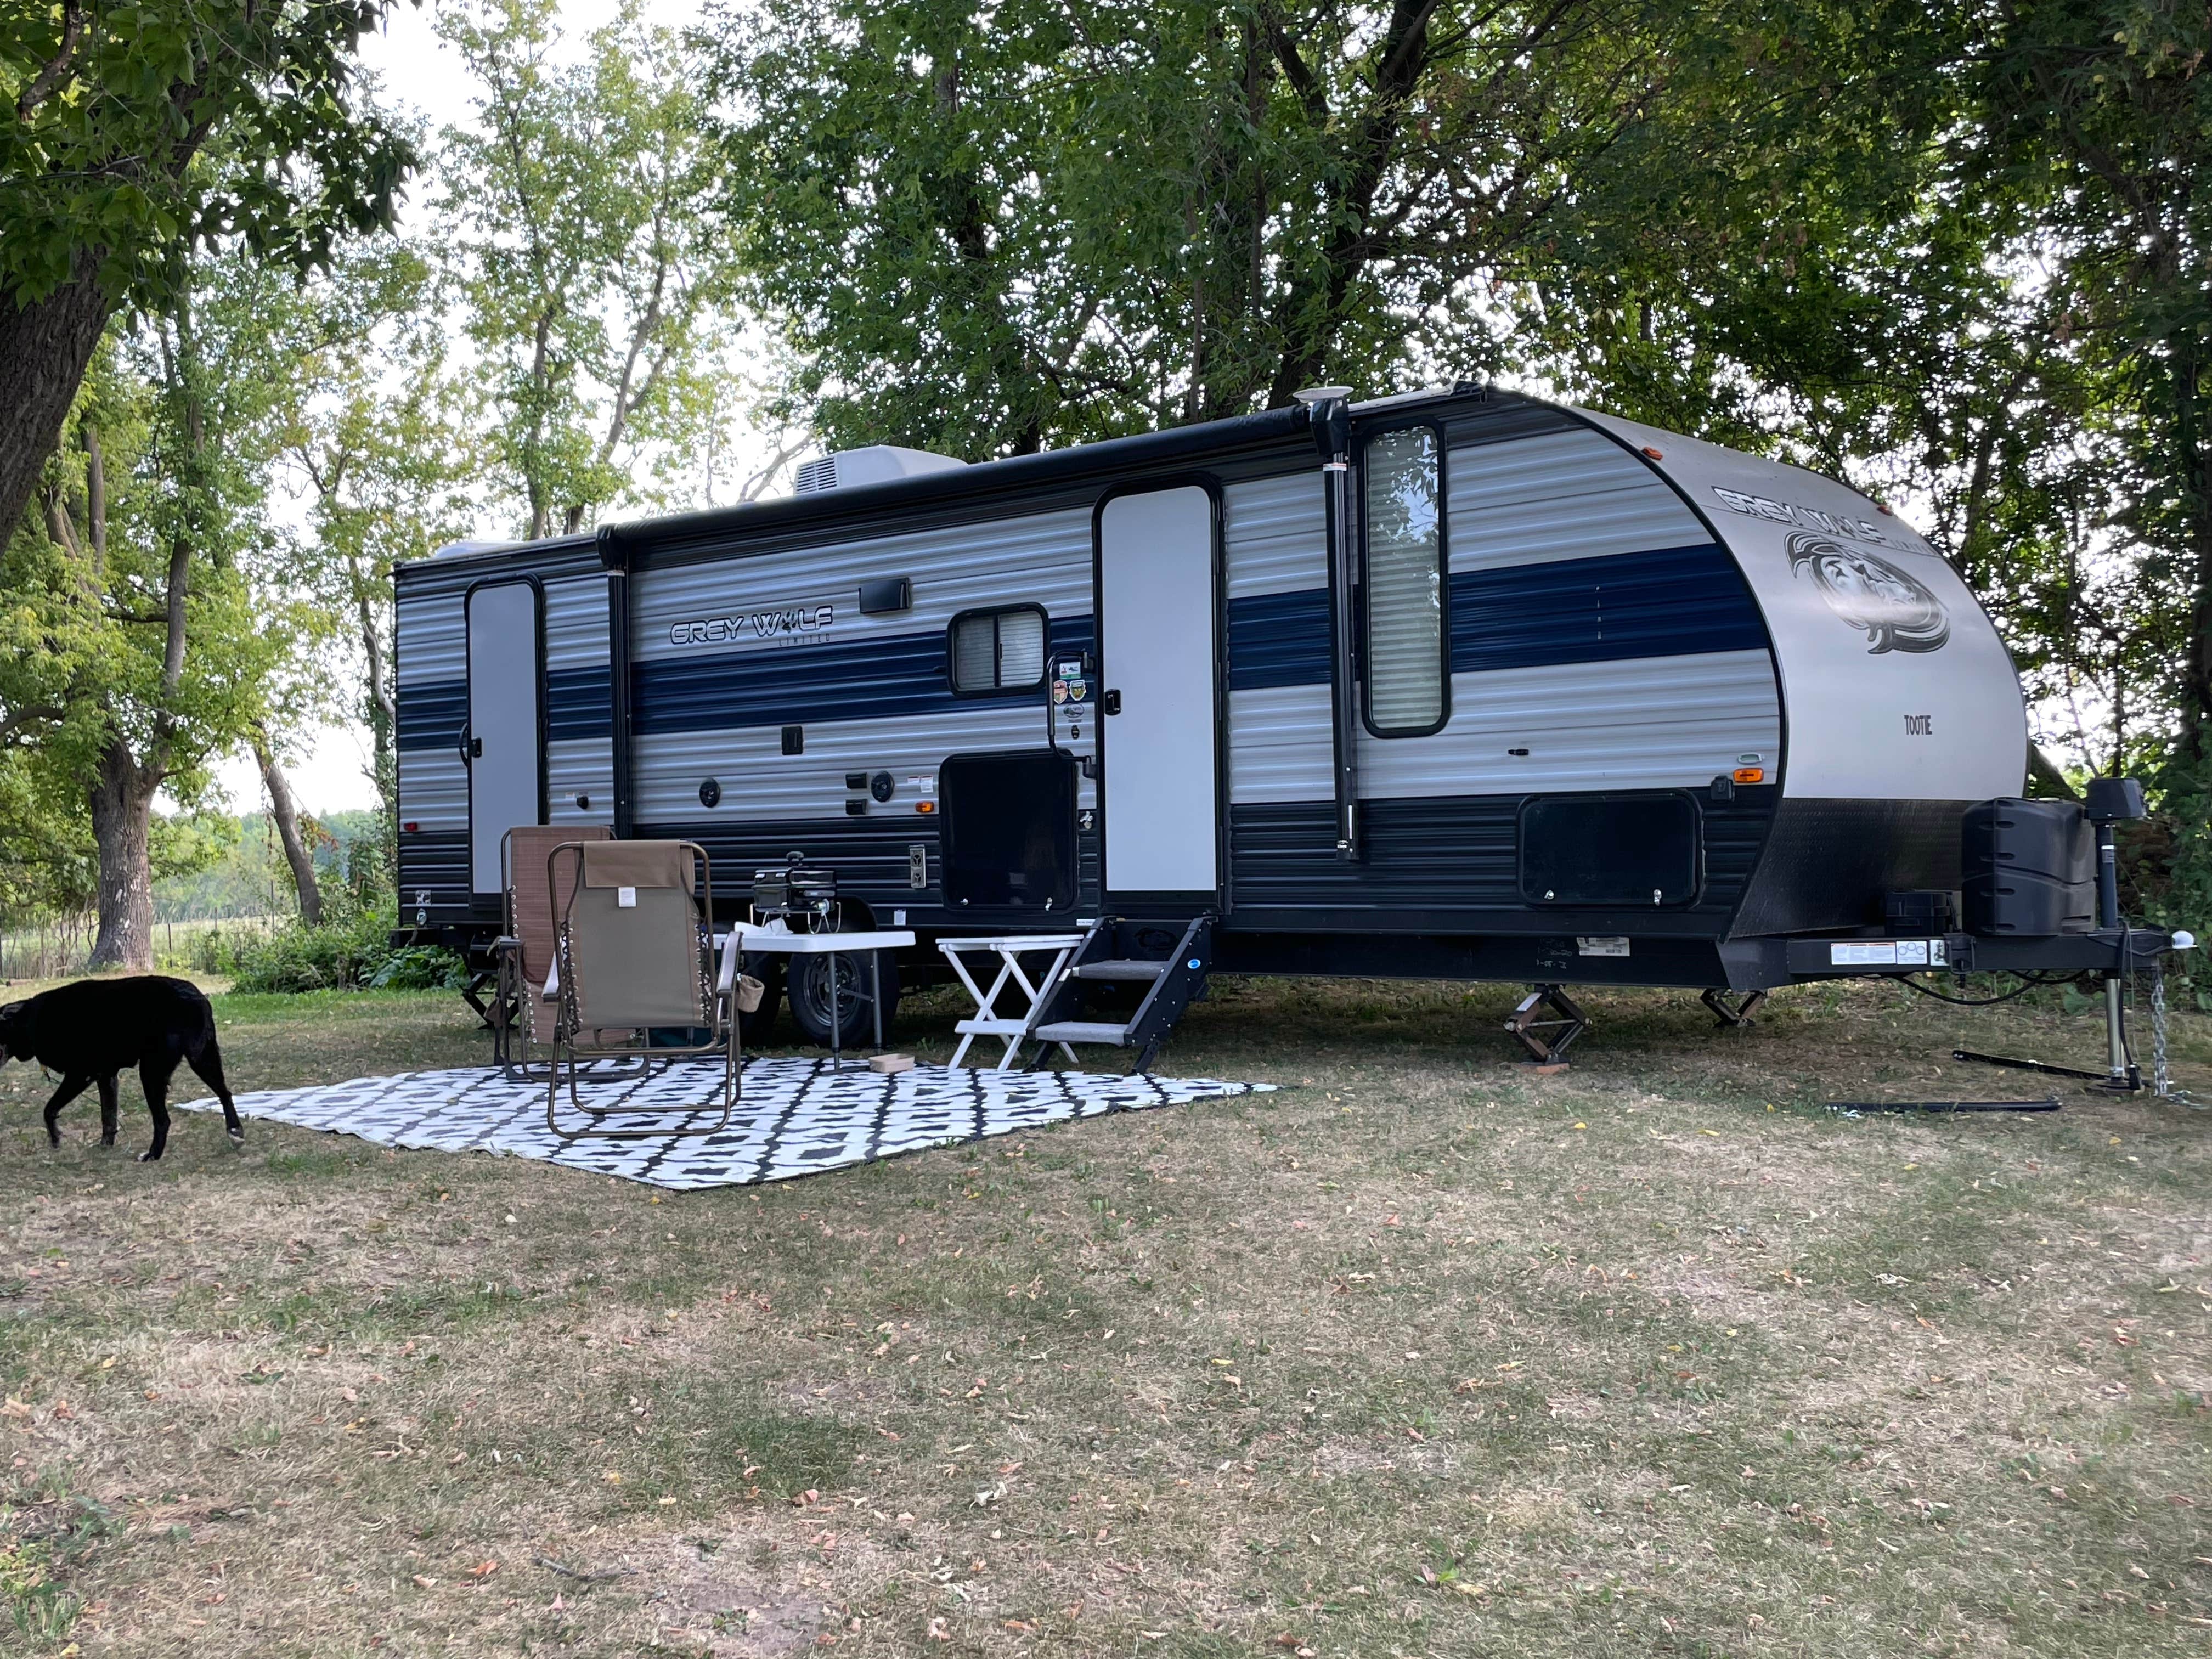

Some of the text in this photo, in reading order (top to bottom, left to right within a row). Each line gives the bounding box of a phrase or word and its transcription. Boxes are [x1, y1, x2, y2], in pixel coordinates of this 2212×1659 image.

[1711, 486, 1803, 526] GREY
[670, 616, 744, 644] GREY
[779, 634, 830, 646] LIMITED
